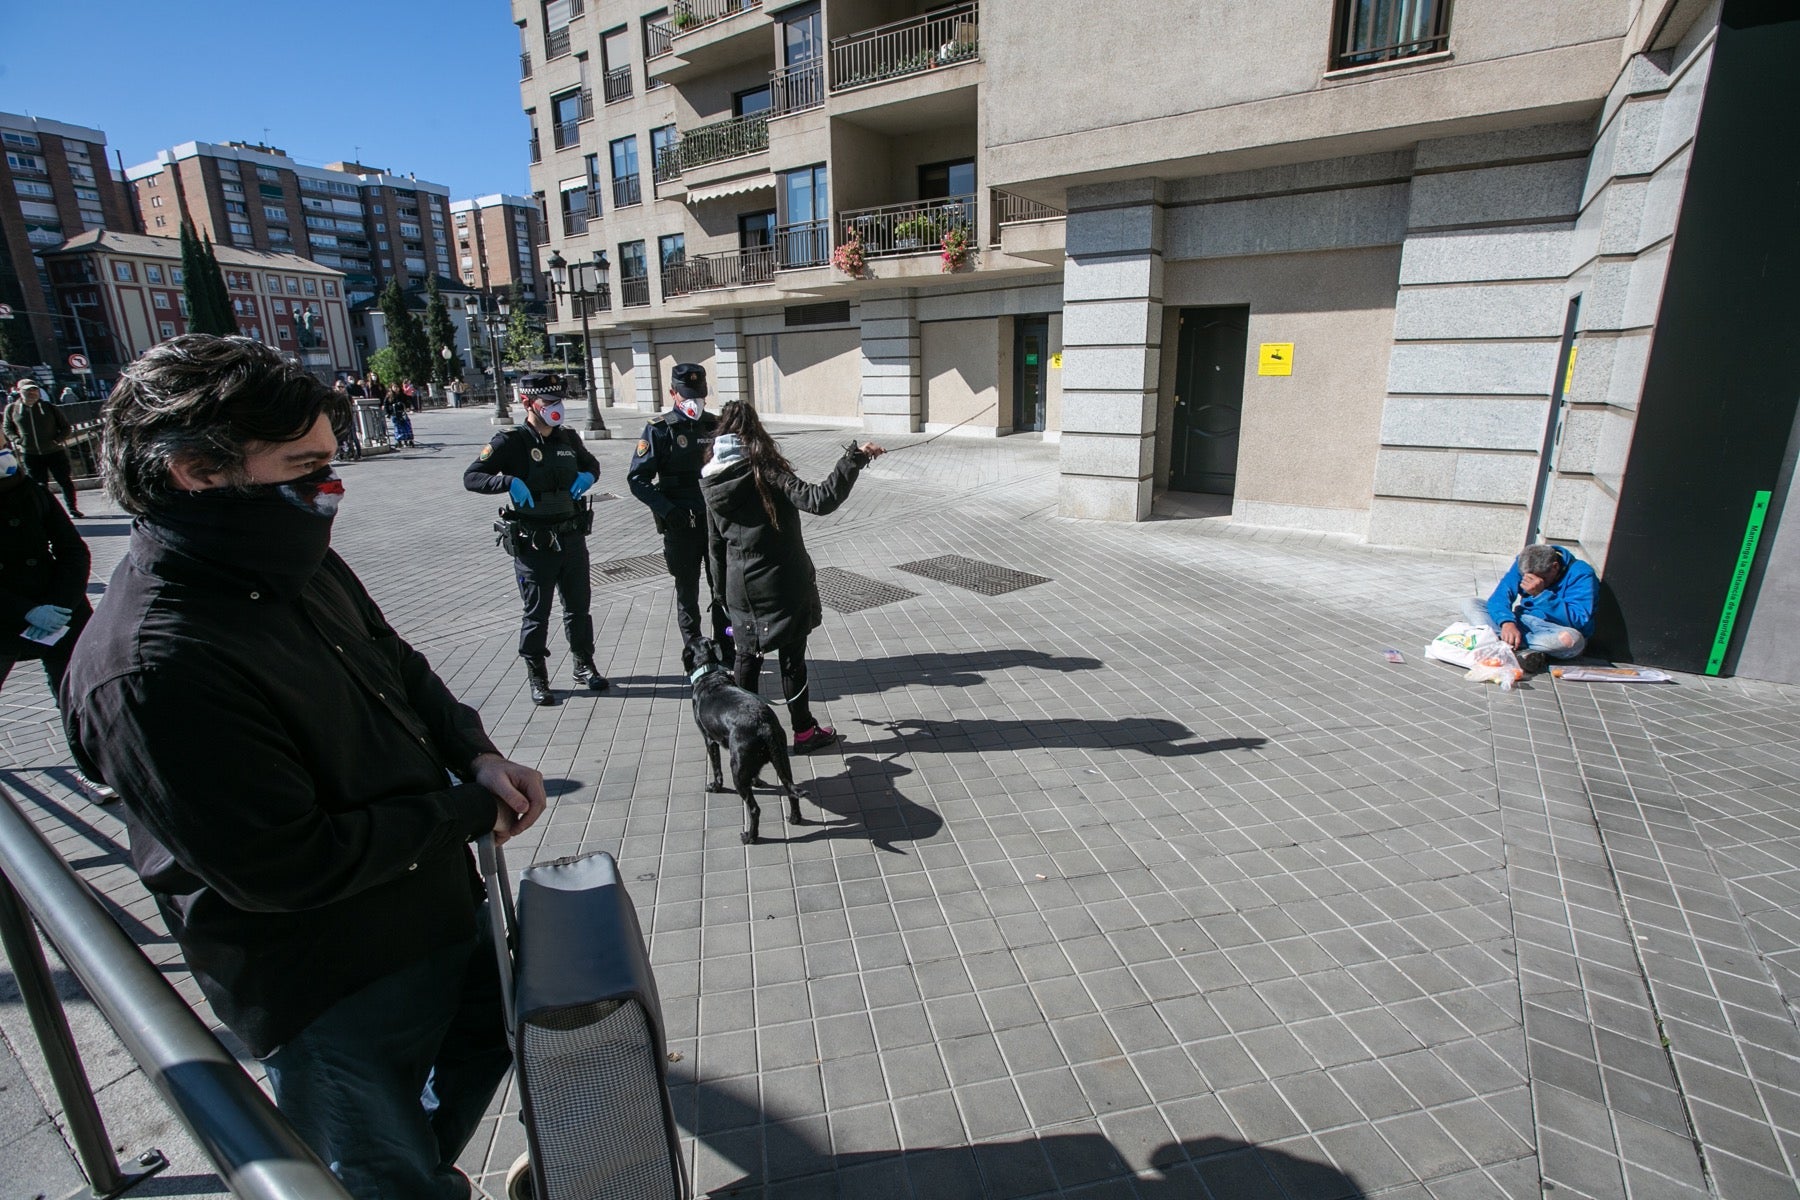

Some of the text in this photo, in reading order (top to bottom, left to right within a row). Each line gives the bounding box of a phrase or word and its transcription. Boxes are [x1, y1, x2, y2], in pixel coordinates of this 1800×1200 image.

[1742, 525, 1758, 559] Mantenga
[1730, 569, 1745, 600] distancia
[1727, 602, 1735, 610] de
[1718, 612, 1731, 645] seguridad
